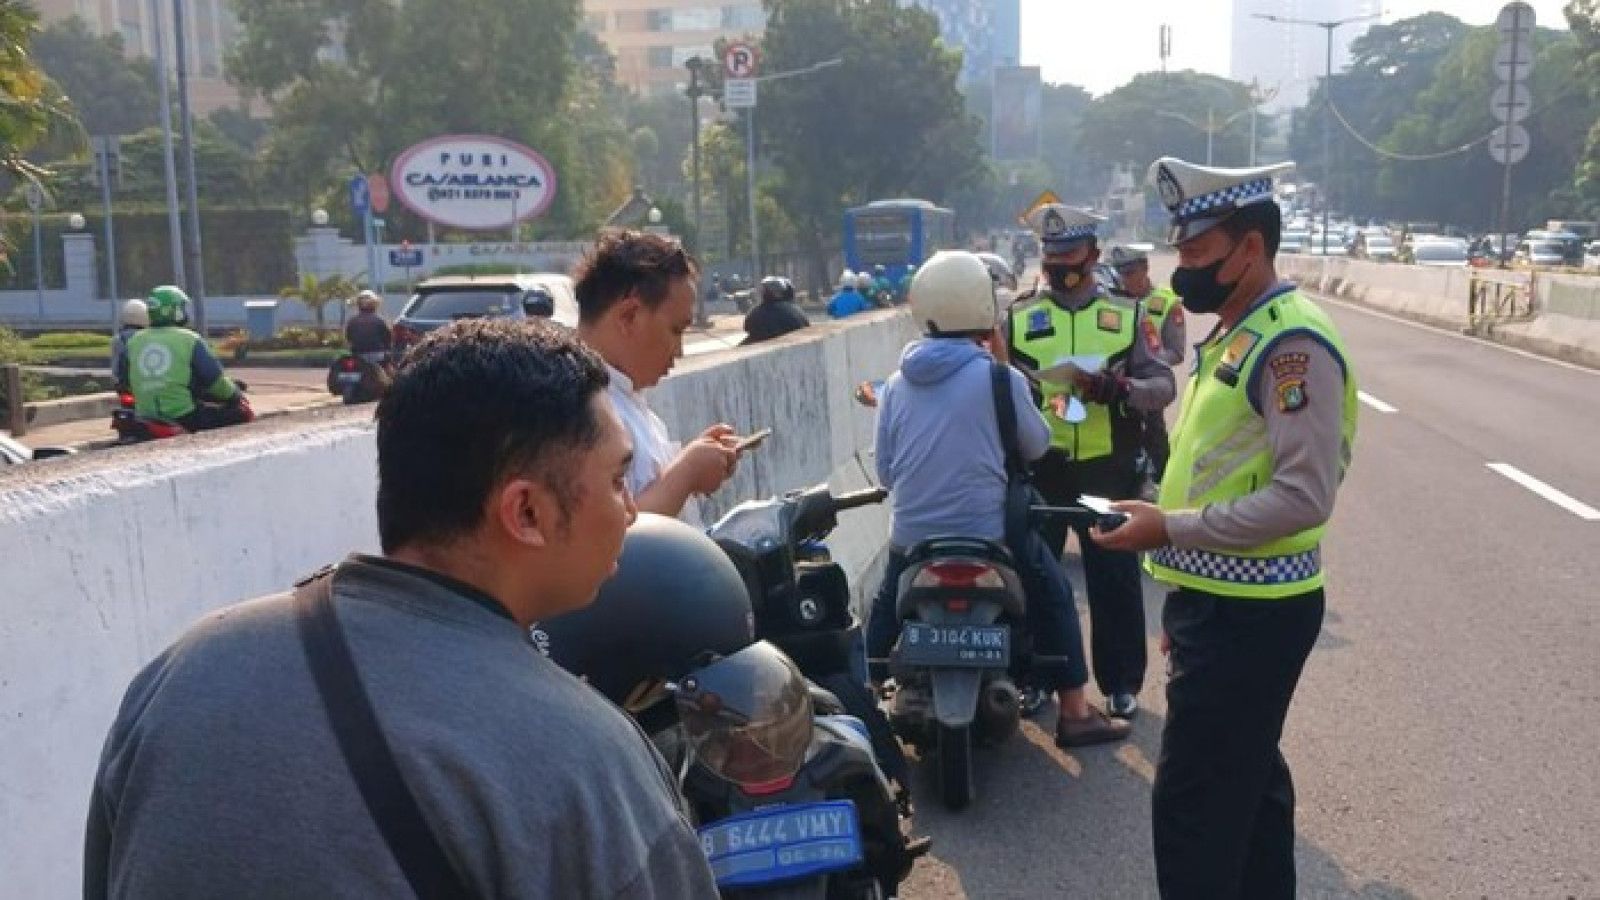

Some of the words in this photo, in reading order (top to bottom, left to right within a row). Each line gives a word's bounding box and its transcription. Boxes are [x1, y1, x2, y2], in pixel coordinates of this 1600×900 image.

[733, 52, 748, 71] P
[405, 172, 541, 188] CASABLANCA
[728, 817, 787, 852] 6444
